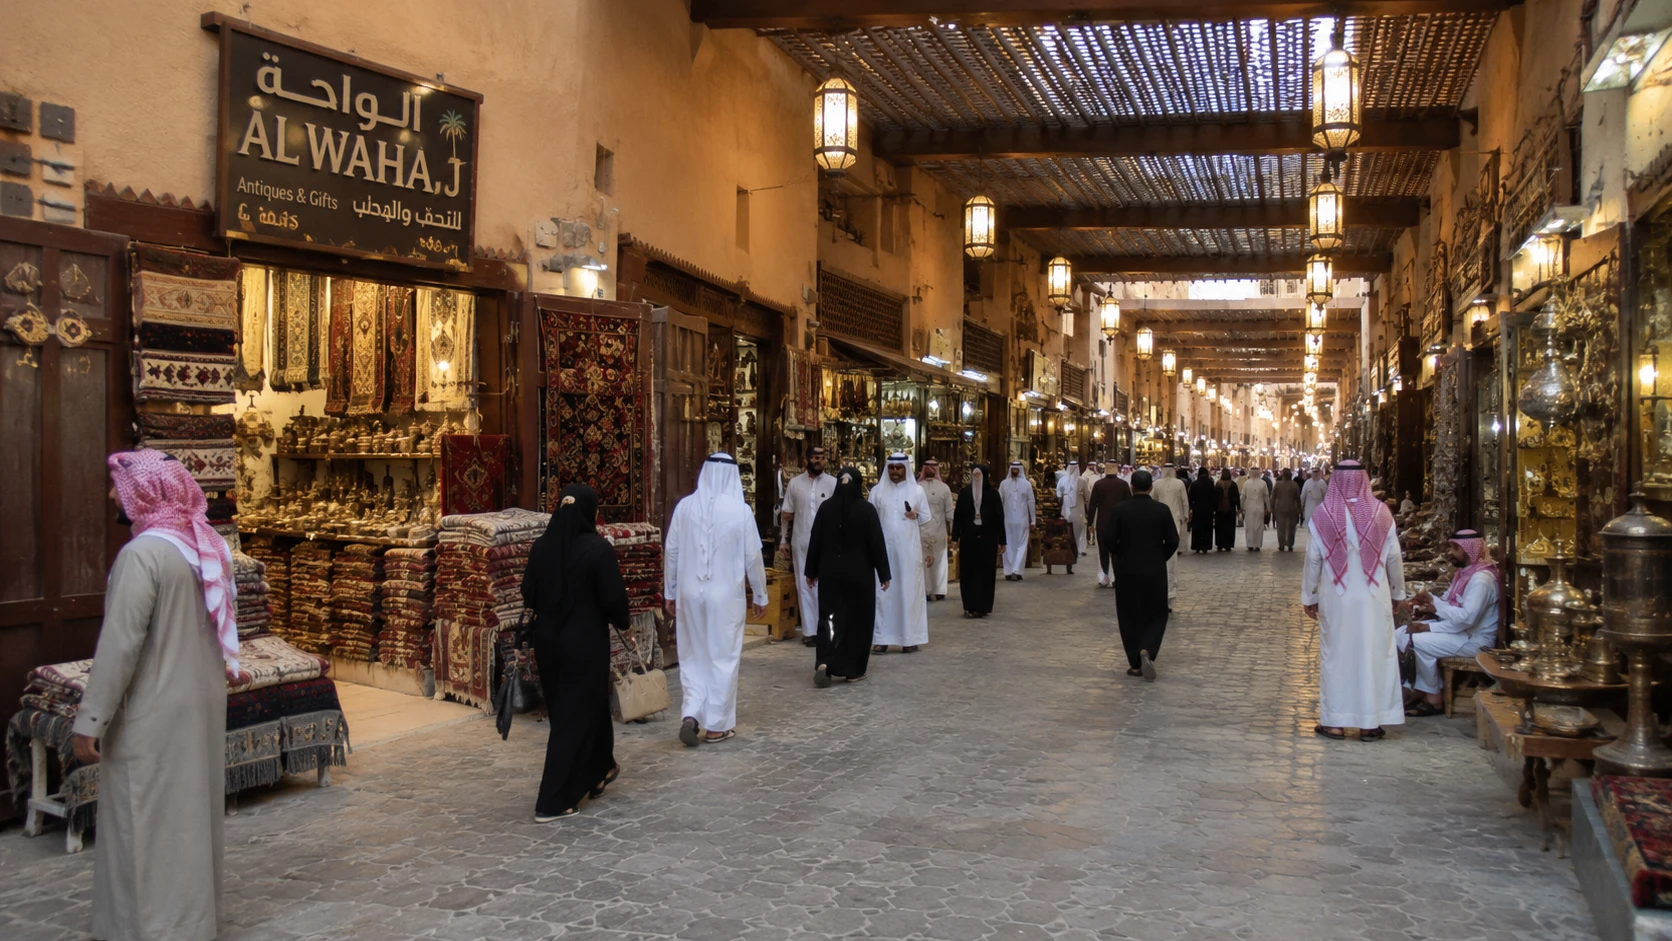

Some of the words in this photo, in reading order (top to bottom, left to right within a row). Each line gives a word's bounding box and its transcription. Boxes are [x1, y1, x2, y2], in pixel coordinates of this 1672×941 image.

[256, 52, 421, 132] الواحة
[236, 109, 299, 166] AL
[237, 176, 293, 201] Antiques
[296, 187, 307, 204] &
[309, 190, 338, 210] Gifts
